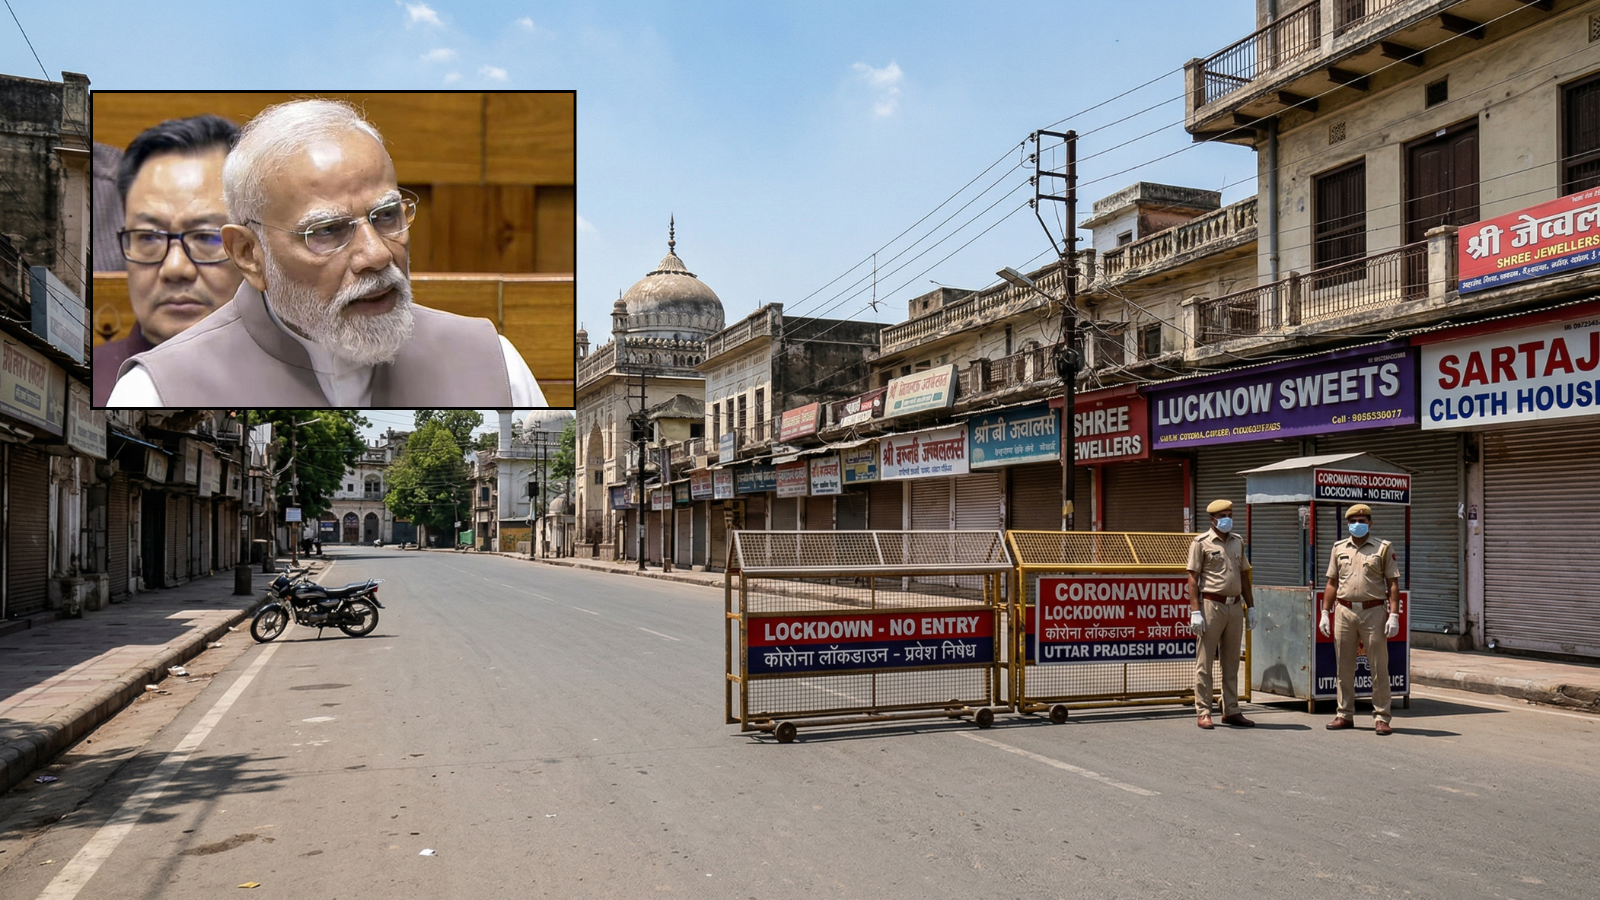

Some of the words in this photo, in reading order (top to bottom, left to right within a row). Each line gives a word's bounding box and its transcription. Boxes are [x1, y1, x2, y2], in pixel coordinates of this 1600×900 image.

[1465, 224, 1504, 260] श्री
[1496, 251, 1531, 269] SHREE
[1534, 234, 1600, 260] JEWELLERS
[1438, 331, 1600, 390] SARTAJ
[1158, 383, 1272, 425] LUCKNOW
[1280, 363, 1399, 410] SWEETS
[1429, 391, 1508, 422] CLOTH
[1074, 405, 1129, 438] SHREE
[1074, 434, 1142, 460] EWELLERS
[1318, 472, 1368, 486] CORONAVIRUS
[1368, 476, 1408, 488] LOCKDOWN
[1320, 485, 1363, 498] LOCKDOWN
[1368, 488, 1379, 499] NO
[1380, 489, 1404, 501] ENTRY
[1045, 605, 1125, 620] LOCKDOWN
[1137, 604, 1157, 619] NO
[764, 619, 873, 641] LOCKDOWN
[890, 618, 916, 636] NO
[921, 616, 980, 635] ENTRY
[1045, 623, 1082, 640] कोरोना
[1084, 623, 1136, 640] लॉकडाउन
[1147, 621, 1172, 638] प्रवेश
[763, 646, 815, 667] कोरोना
[818, 644, 889, 665] लॉकडाउन
[904, 641, 938, 661] प्रवेश
[941, 639, 977, 660] निषेध
[1044, 644, 1090, 659] UTTAR
[1093, 643, 1154, 657] PRADESH
[1158, 642, 1195, 655] POLIC
[1318, 676, 1338, 690] UTTA
[1389, 674, 1404, 686] LICE
